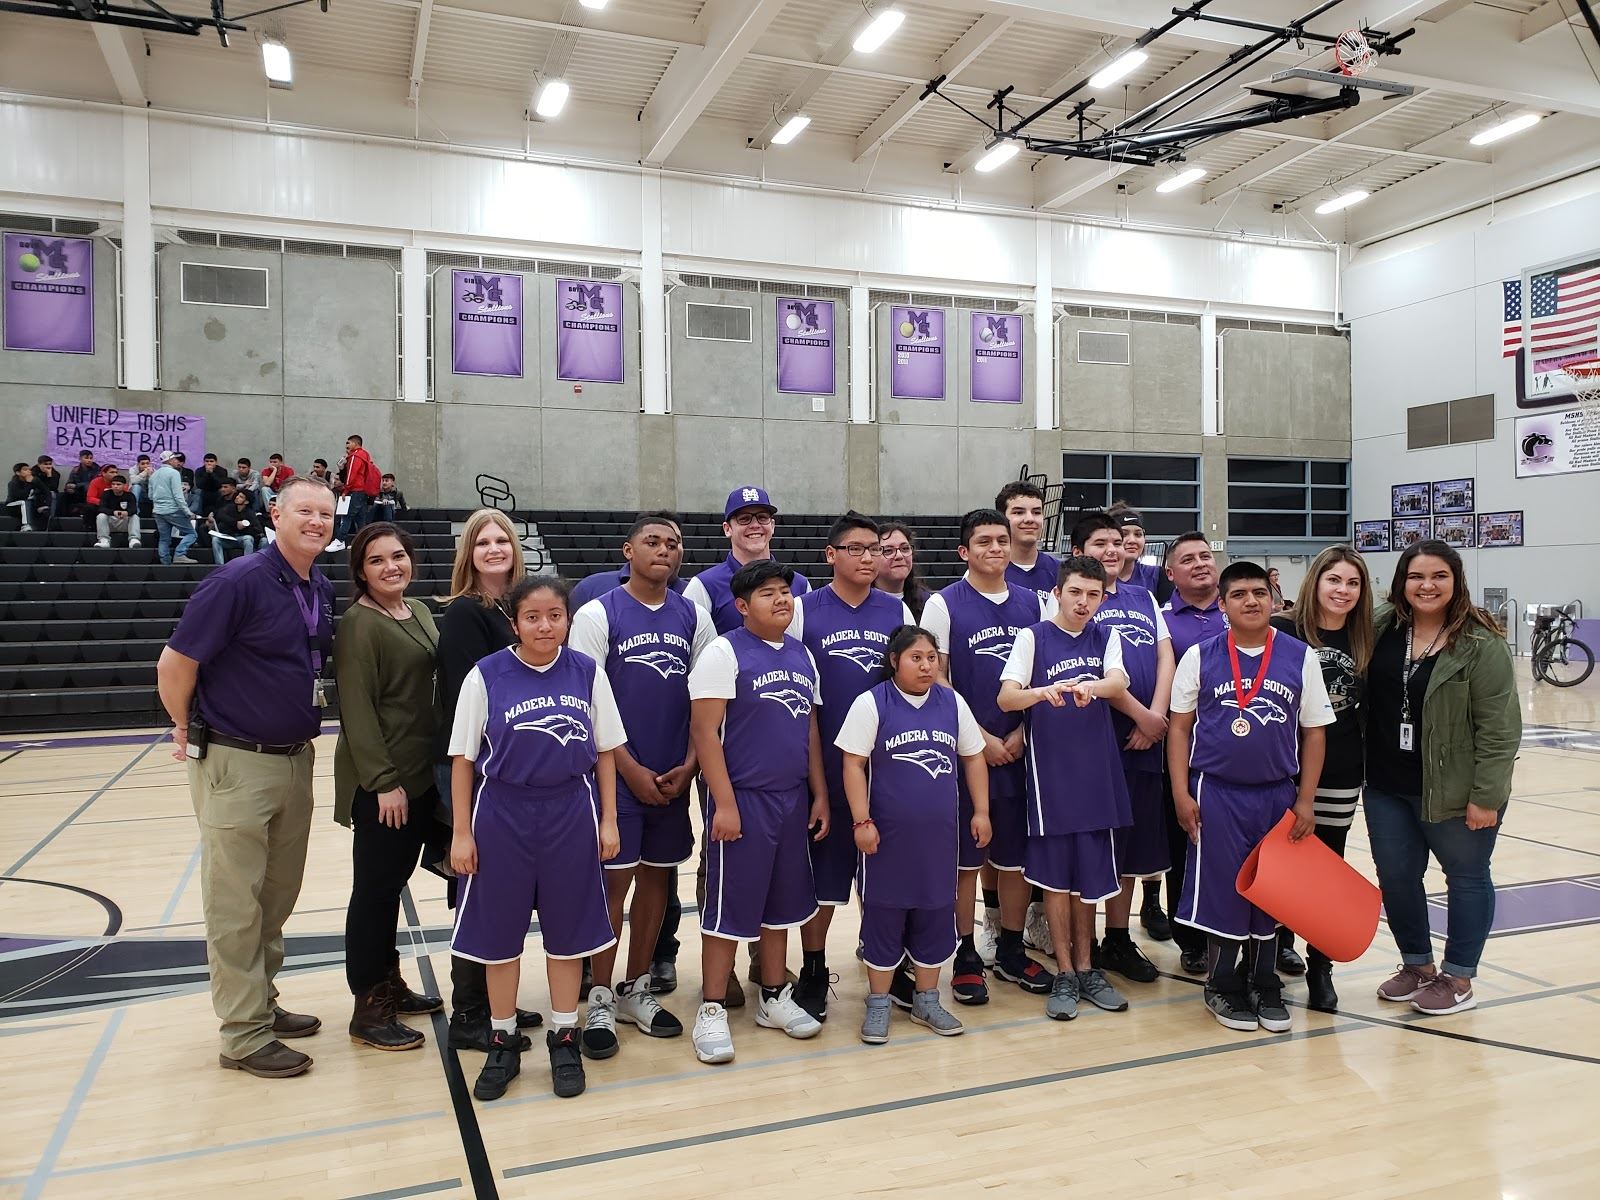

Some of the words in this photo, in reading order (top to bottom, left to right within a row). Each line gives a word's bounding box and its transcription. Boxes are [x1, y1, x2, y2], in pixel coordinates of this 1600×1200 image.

[14, 282, 84, 294] CHAMPIONS
[461, 314, 515, 324] CHAMPIONS
[565, 321, 617, 331] CHAMPIONS
[784, 338, 829, 347] CHAMPIONS
[897, 345, 940, 353] CHAMPIONS
[977, 350, 1017, 358] CHAMPIONS
[51, 405, 119, 425] UNIFIED
[137, 413, 187, 432] MSHS
[1093, 608, 1127, 624] MADERA
[617, 632, 660, 655] MADERA
[821, 629, 861, 649] MADERA
[863, 630, 891, 645] SOUT
[968, 625, 1005, 648] MADERA
[1046, 656, 1086, 680] MADERA
[753, 670, 790, 691] MADERA
[1263, 678, 1295, 704] SOUTH
[504, 695, 556, 724] MADERA
[885, 729, 929, 752] MADERA
